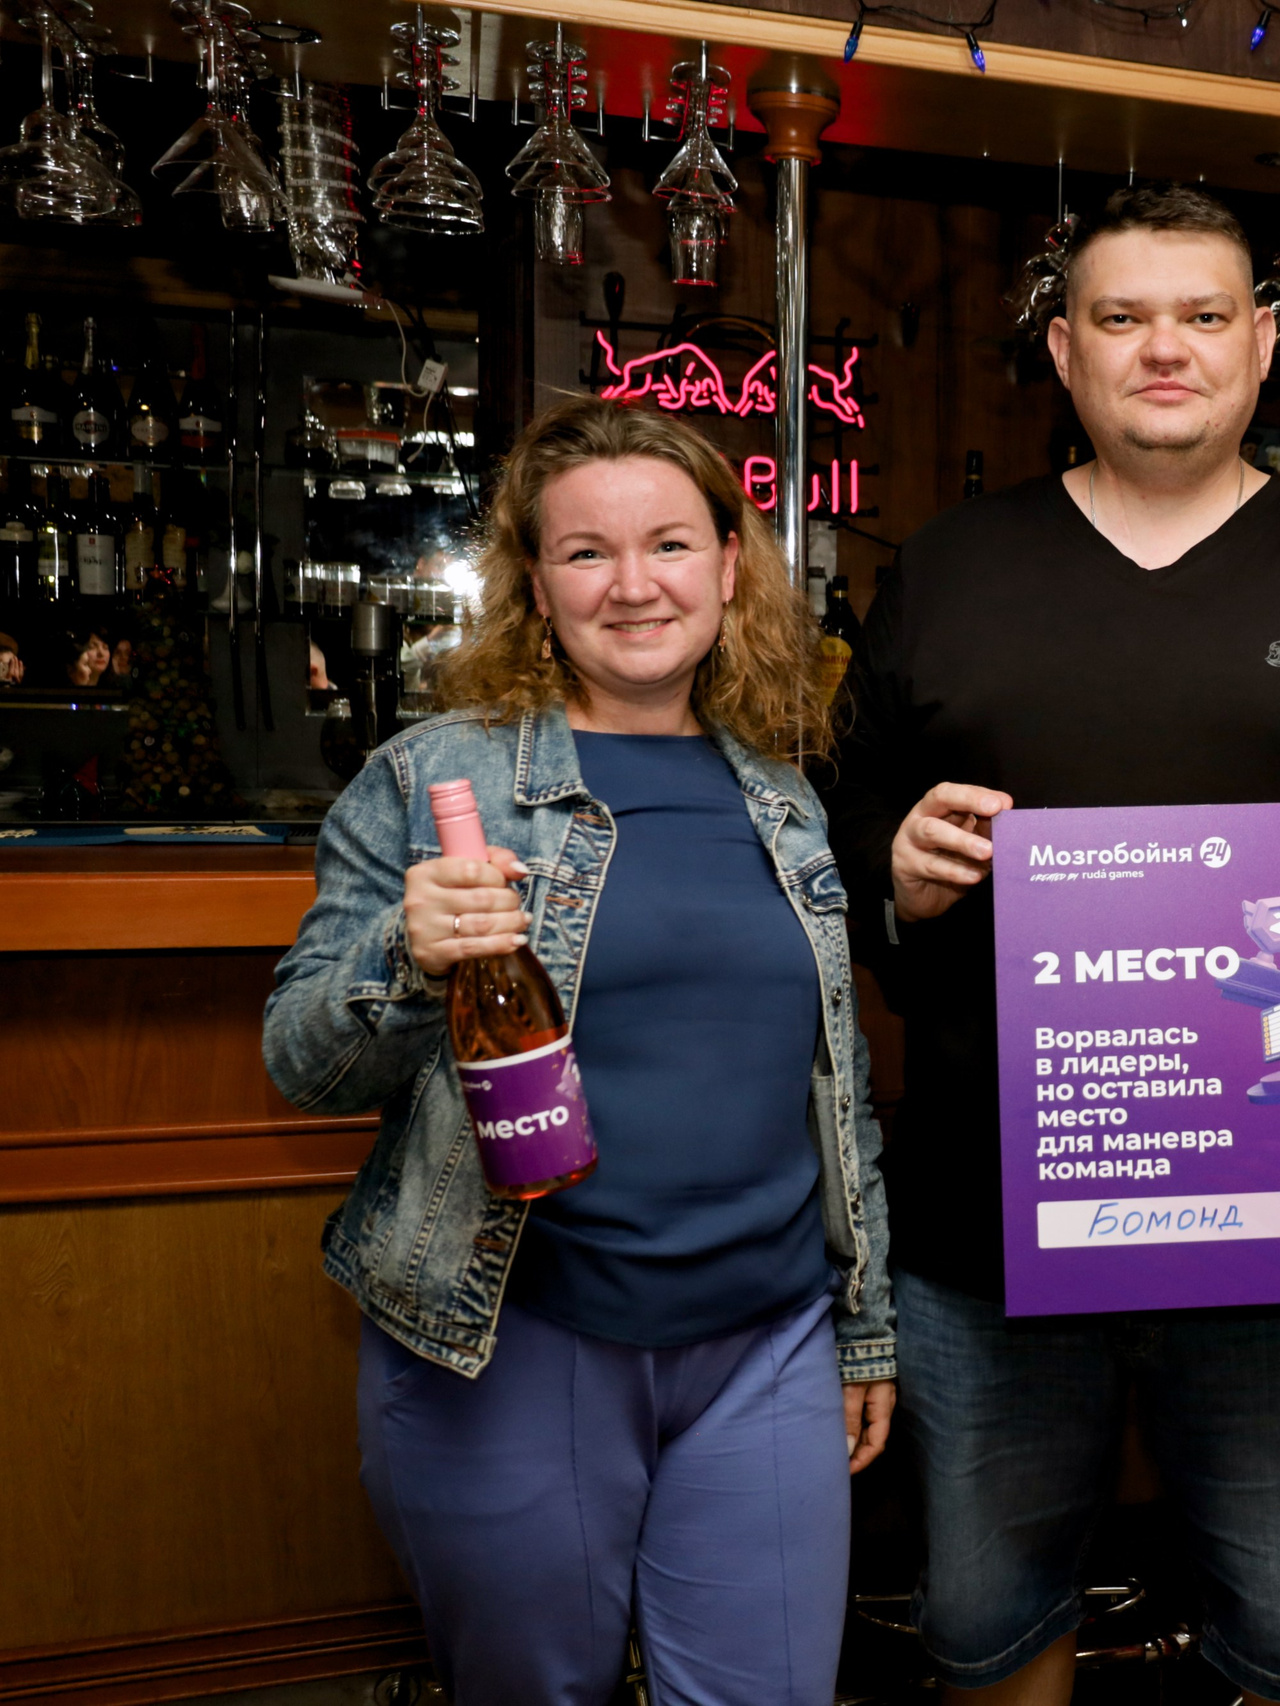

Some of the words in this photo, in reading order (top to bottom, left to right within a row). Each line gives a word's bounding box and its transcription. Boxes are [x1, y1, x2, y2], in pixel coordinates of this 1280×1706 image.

[1029, 842, 1193, 866] Мозгобойня
[1108, 869, 1144, 881] games
[1032, 951, 1062, 985] 2
[1075, 946, 1240, 984] МЕСТО
[1035, 1025, 1198, 1052] Ворвалась
[1036, 1058, 1053, 1075] в
[1060, 1052, 1190, 1077] лидеры,
[1037, 1083, 1074, 1101] но
[1082, 1077, 1223, 1100] оставила
[1037, 1106, 1128, 1128] место
[1037, 1134, 1093, 1157] для
[1103, 1128, 1233, 1153] маневра
[1039, 1157, 1171, 1180] команда
